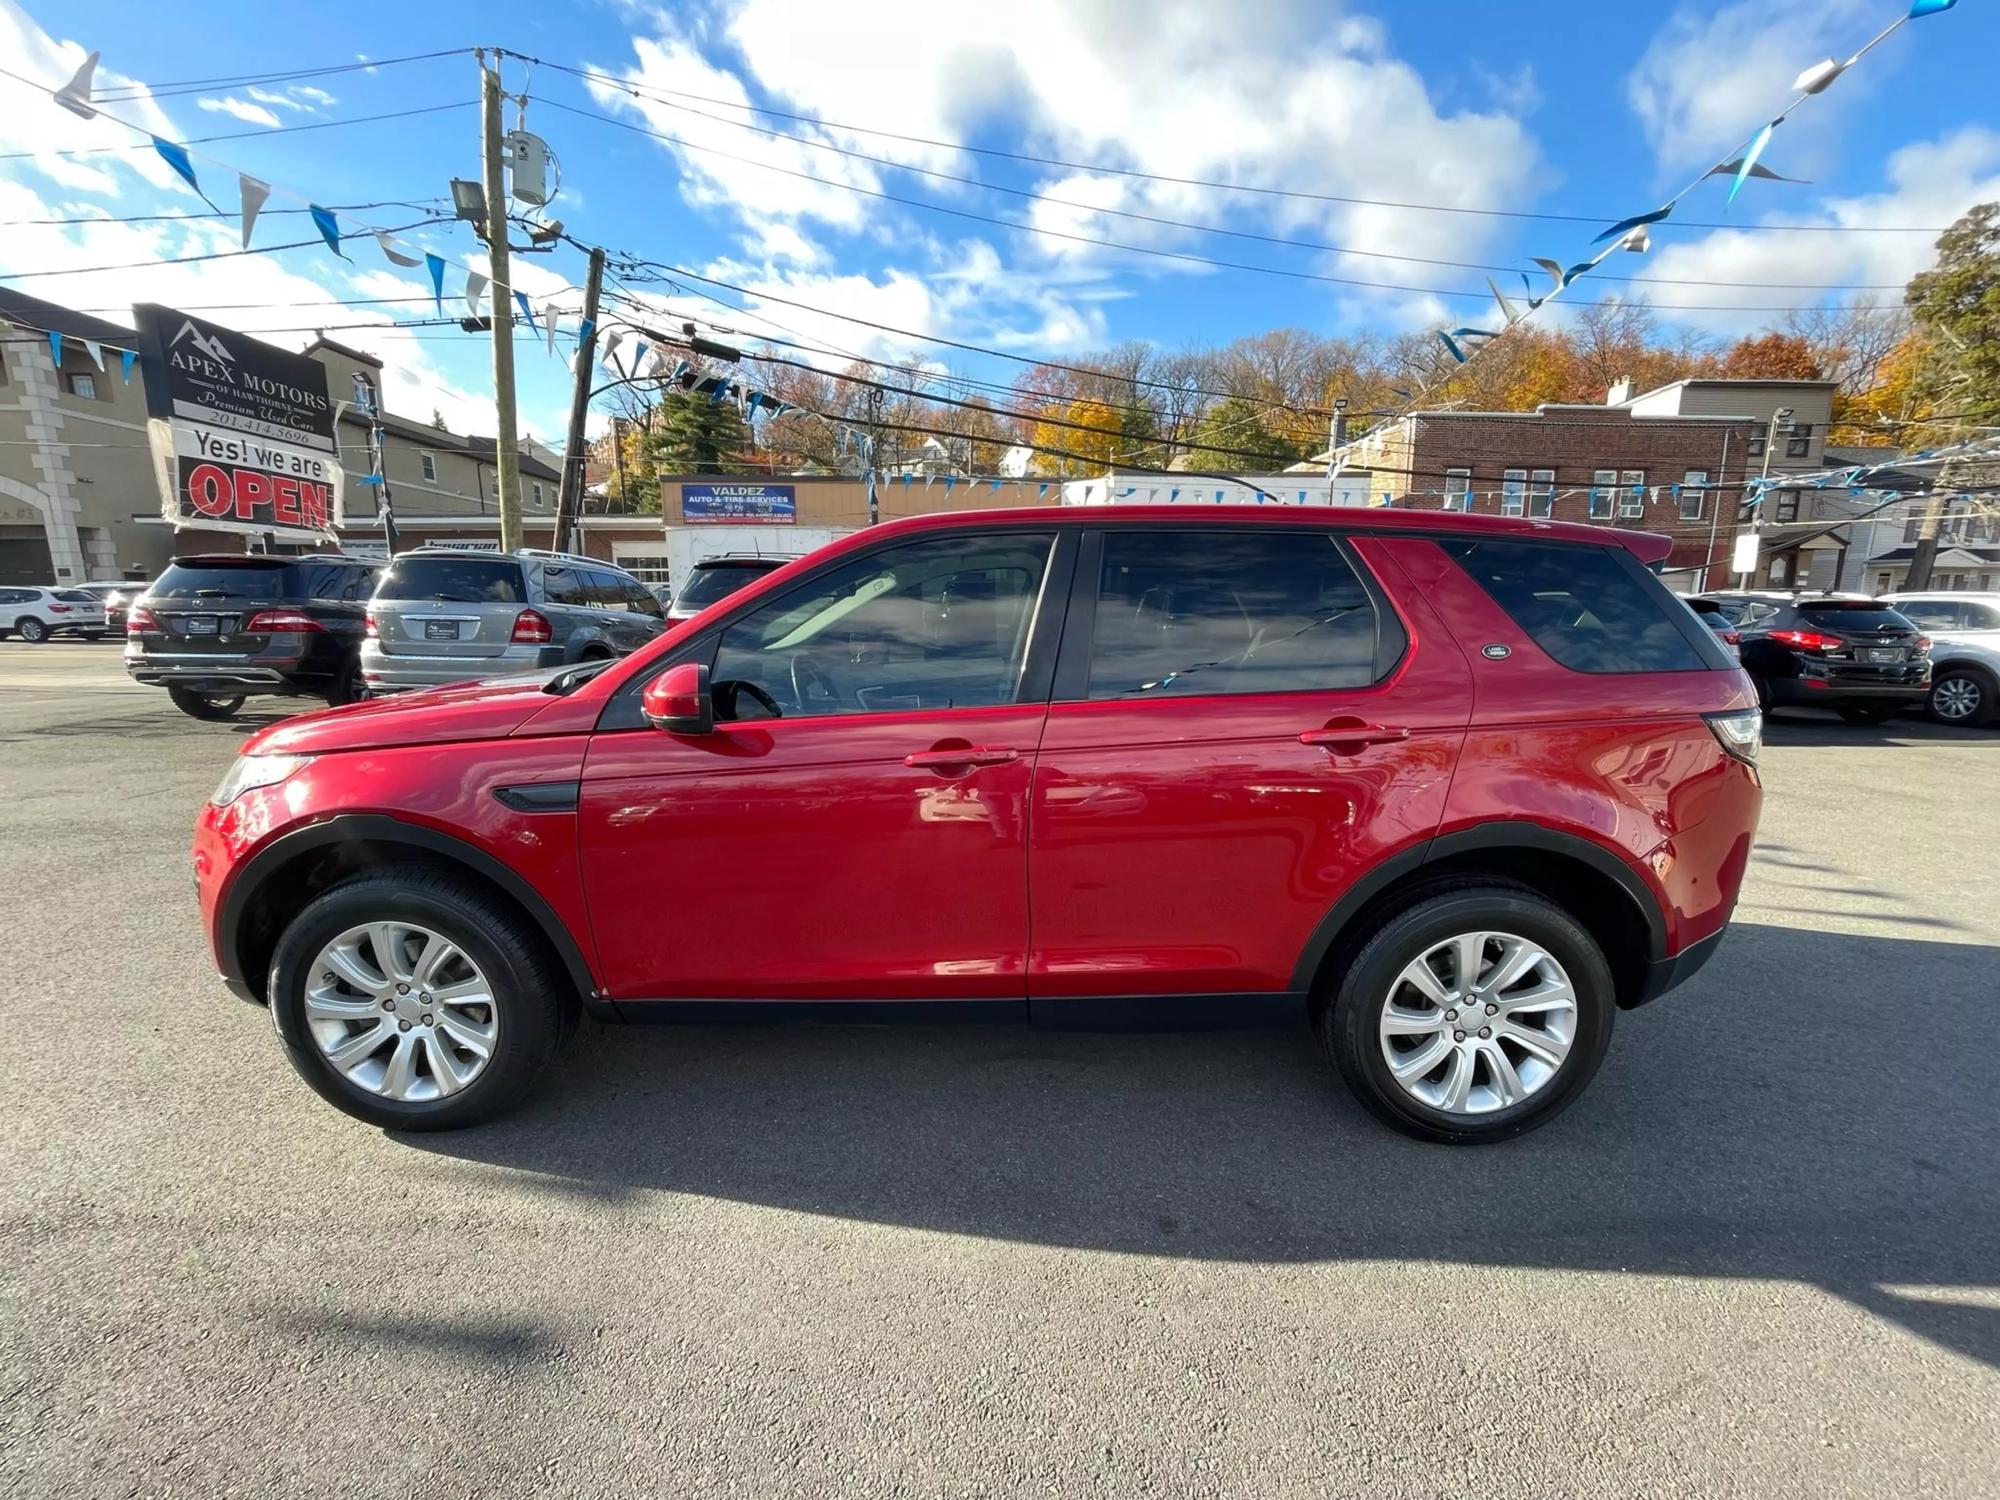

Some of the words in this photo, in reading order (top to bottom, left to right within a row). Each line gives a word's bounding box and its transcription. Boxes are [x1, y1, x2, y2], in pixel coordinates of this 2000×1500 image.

[169, 351, 236, 384] APEX
[243, 372, 328, 411] MOTORS
[215, 385, 229, 395] OF
[232, 388, 293, 412] HAWTHORNE
[197, 391, 255, 416] Premium
[258, 406, 287, 425] Used
[288, 411, 315, 432] Cars
[209, 411, 309, 444] 201.414.5696
[194, 430, 249, 463] Yes!
[254, 447, 284, 470] we
[291, 461, 322, 477] are
[189, 464, 328, 528] OPEN
[711, 487, 765, 496] VALDEZ
